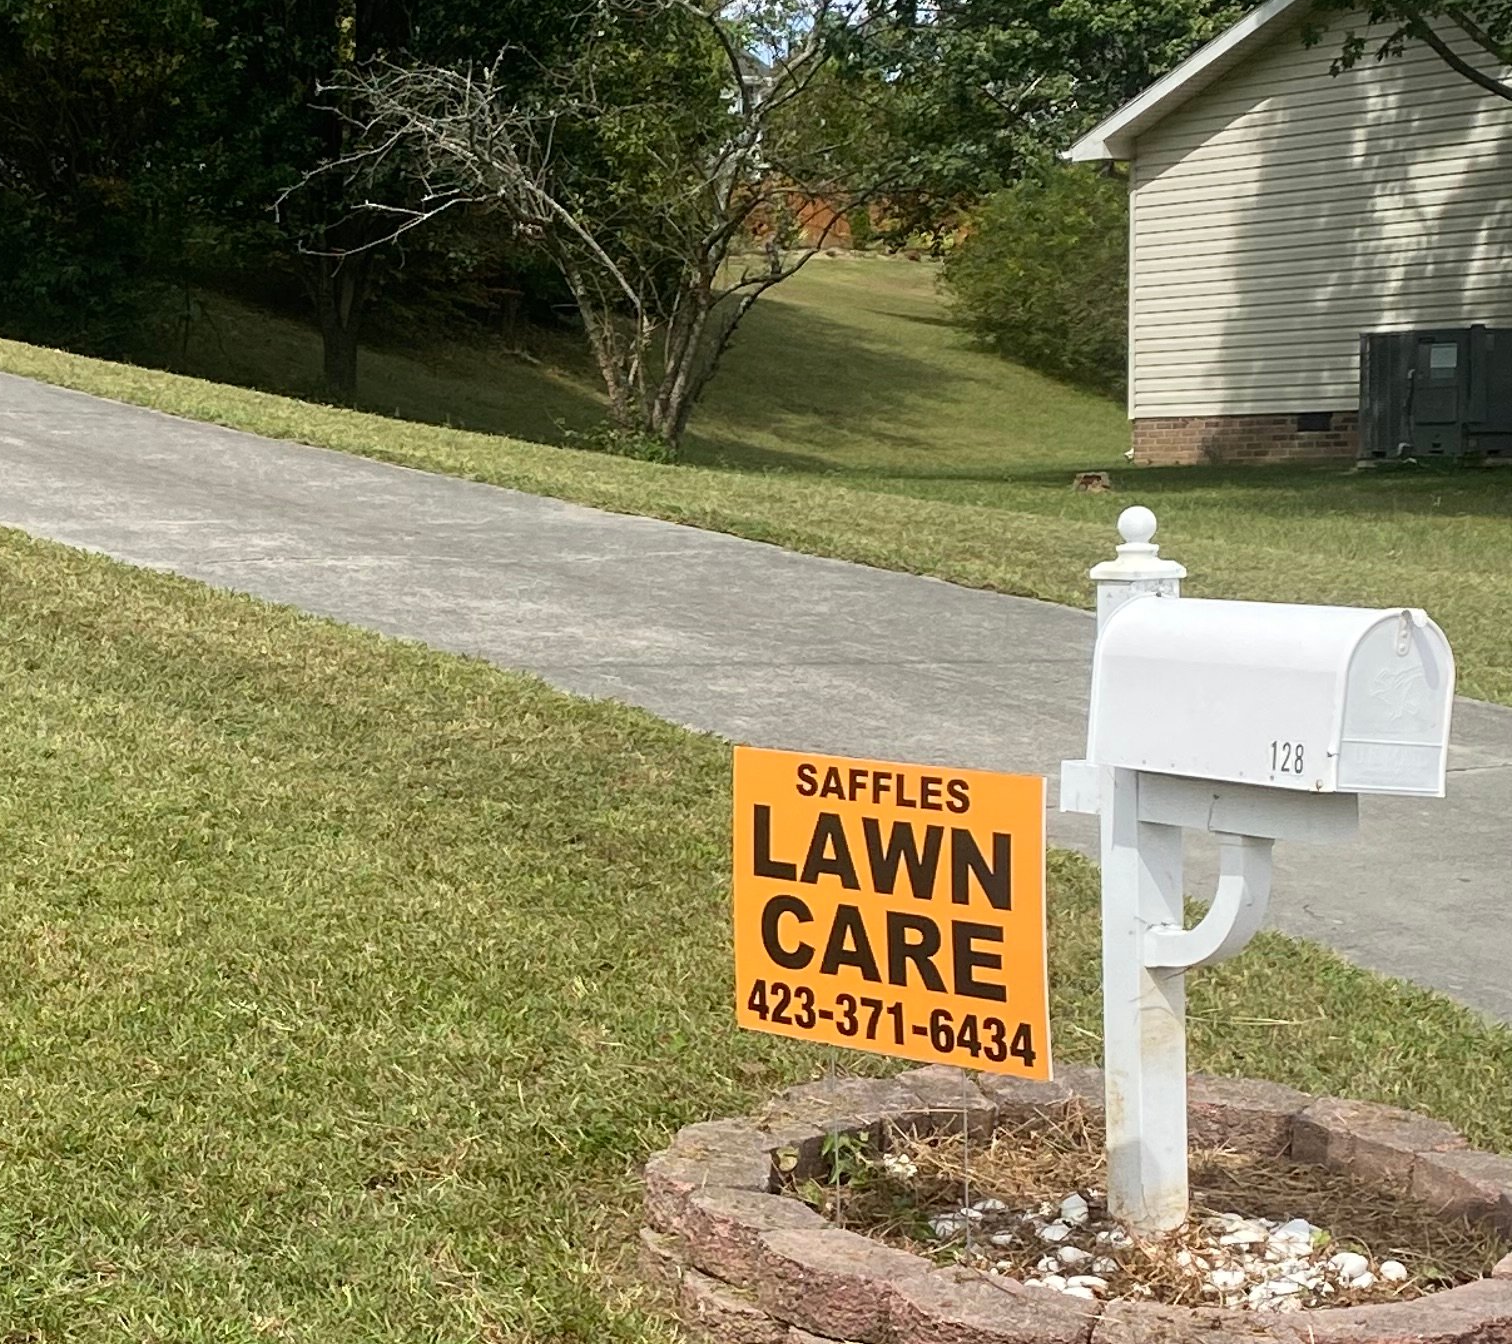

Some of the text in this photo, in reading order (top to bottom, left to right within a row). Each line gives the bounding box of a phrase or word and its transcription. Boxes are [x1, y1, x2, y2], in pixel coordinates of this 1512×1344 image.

[795, 763, 971, 814] SAFFLES
[1271, 741, 1305, 774] 128
[753, 803, 1012, 912] LAWN
[760, 894, 1008, 1004] CARE
[747, 978, 1037, 1068] 423-371-6434
